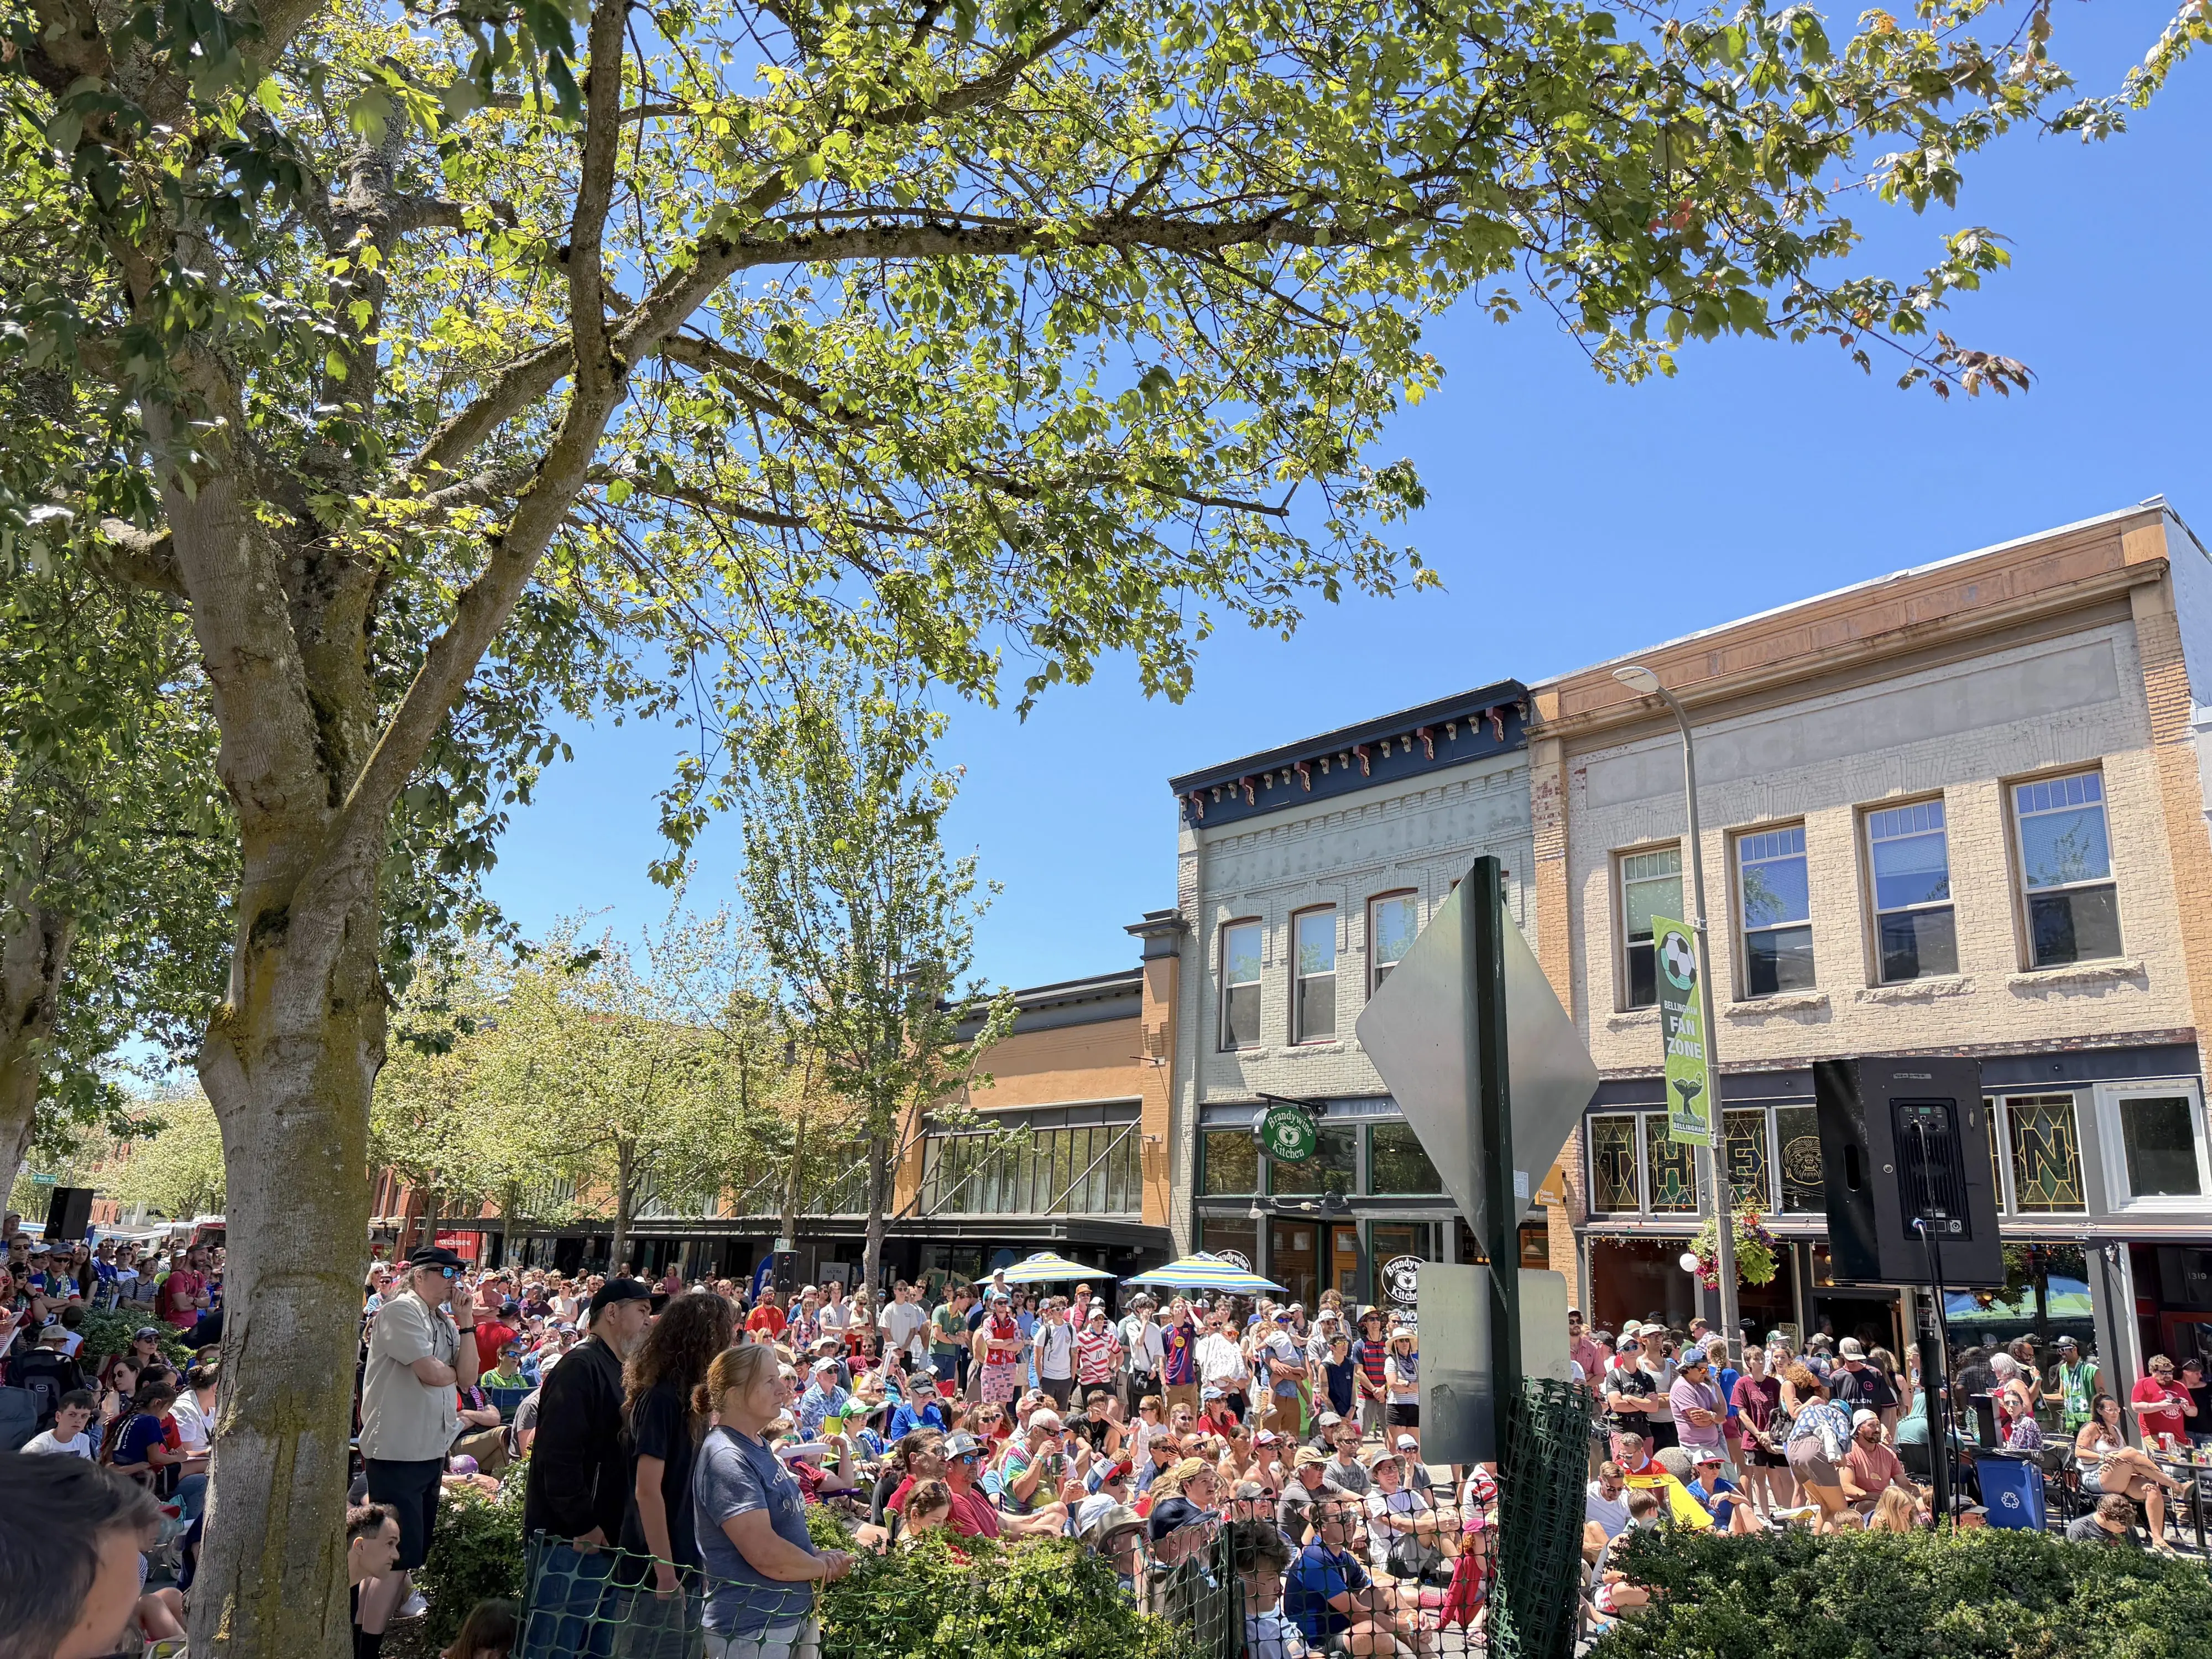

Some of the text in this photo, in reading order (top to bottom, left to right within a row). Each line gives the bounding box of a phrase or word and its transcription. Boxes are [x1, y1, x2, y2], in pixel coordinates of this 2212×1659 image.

[1664, 1000, 1698, 1015] BELLINGHAM
[1670, 1015, 1695, 1036] FAN
[1667, 1036, 1703, 1059] ZONE
[1267, 1110, 1313, 1136] Brandywine
[1673, 1122, 1705, 1133] BELLINGHAM
[1272, 1139, 1305, 1159] Kitchen
[1218, 1251, 1249, 1270] andywine
[1385, 1257, 1420, 1277] Brandyw
[1095, 1350, 1102, 1360] 10
